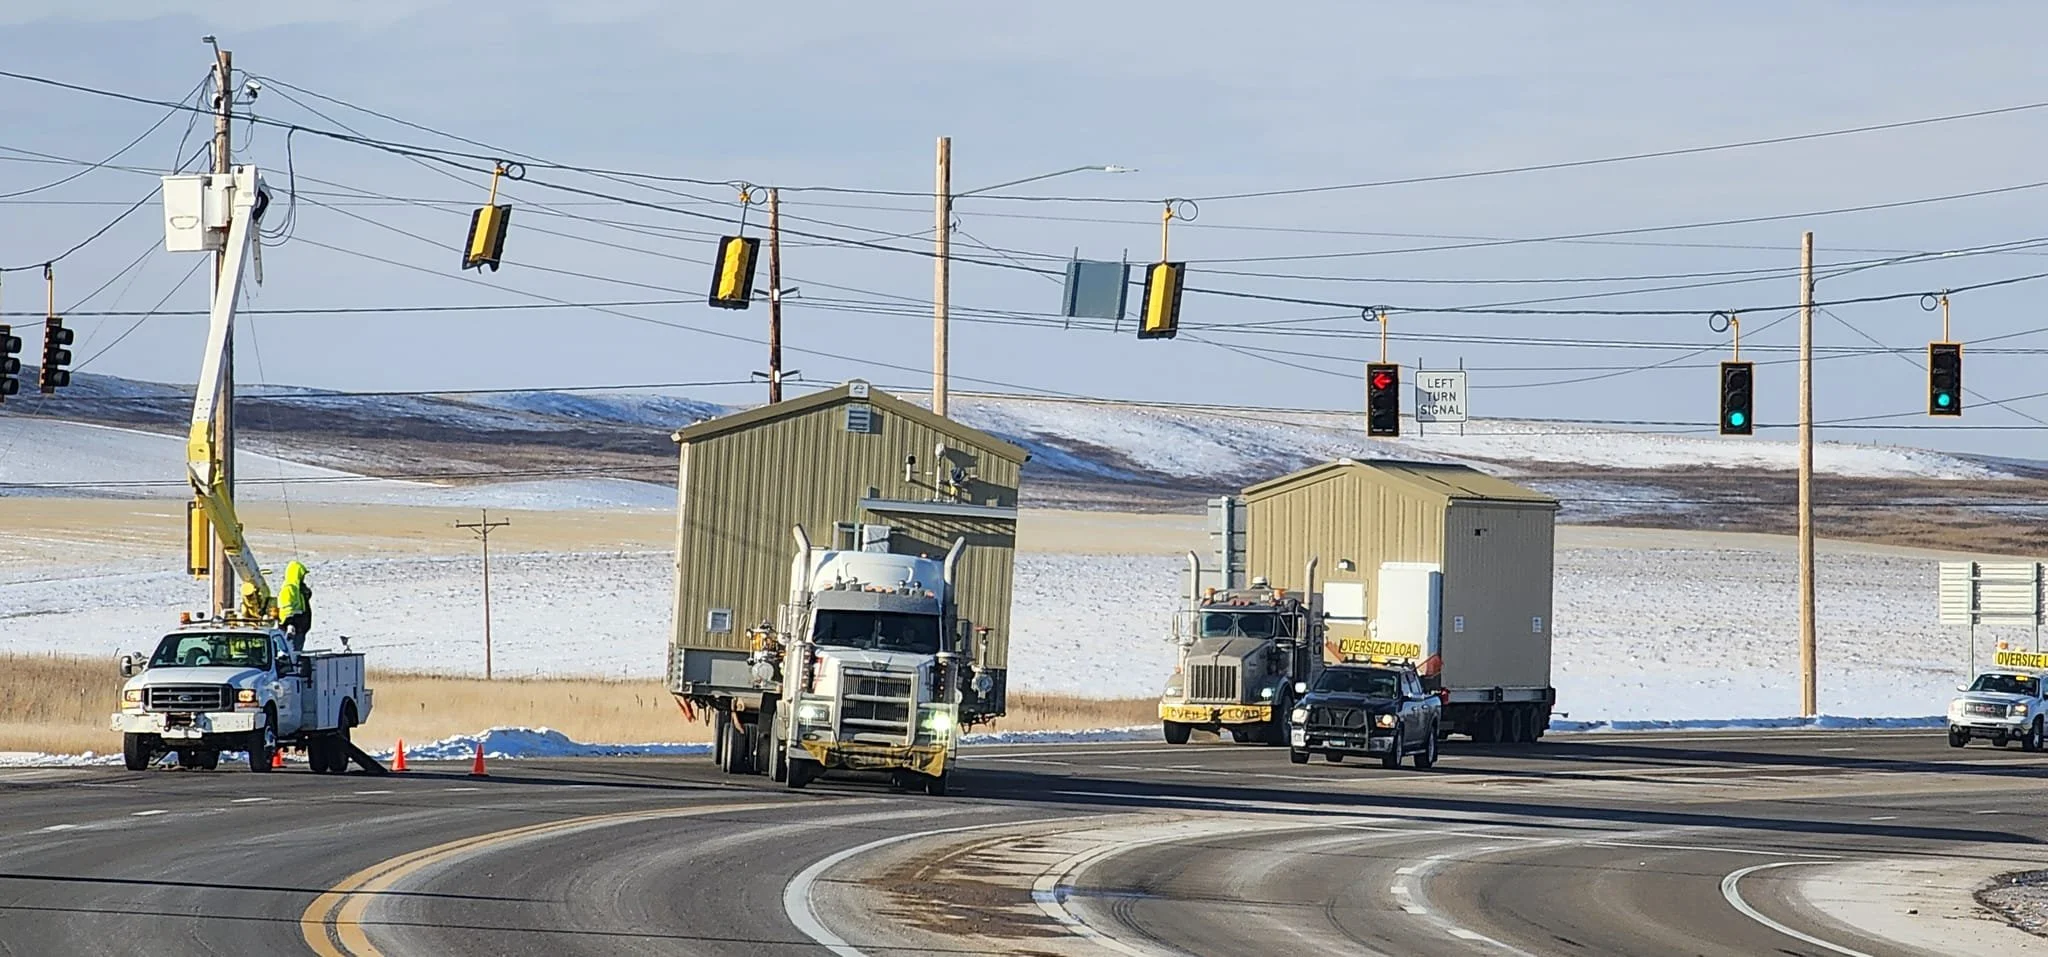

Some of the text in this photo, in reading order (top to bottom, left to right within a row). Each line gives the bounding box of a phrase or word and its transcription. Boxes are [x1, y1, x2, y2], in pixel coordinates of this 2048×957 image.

[1427, 378, 1455, 389] LEFT
[1427, 391, 1457, 402] TURN
[1420, 404, 1463, 416] SIGNAL
[1341, 639, 1419, 657] OVERSIZED LOAD
[1997, 651, 2042, 668] OVERSIZE
